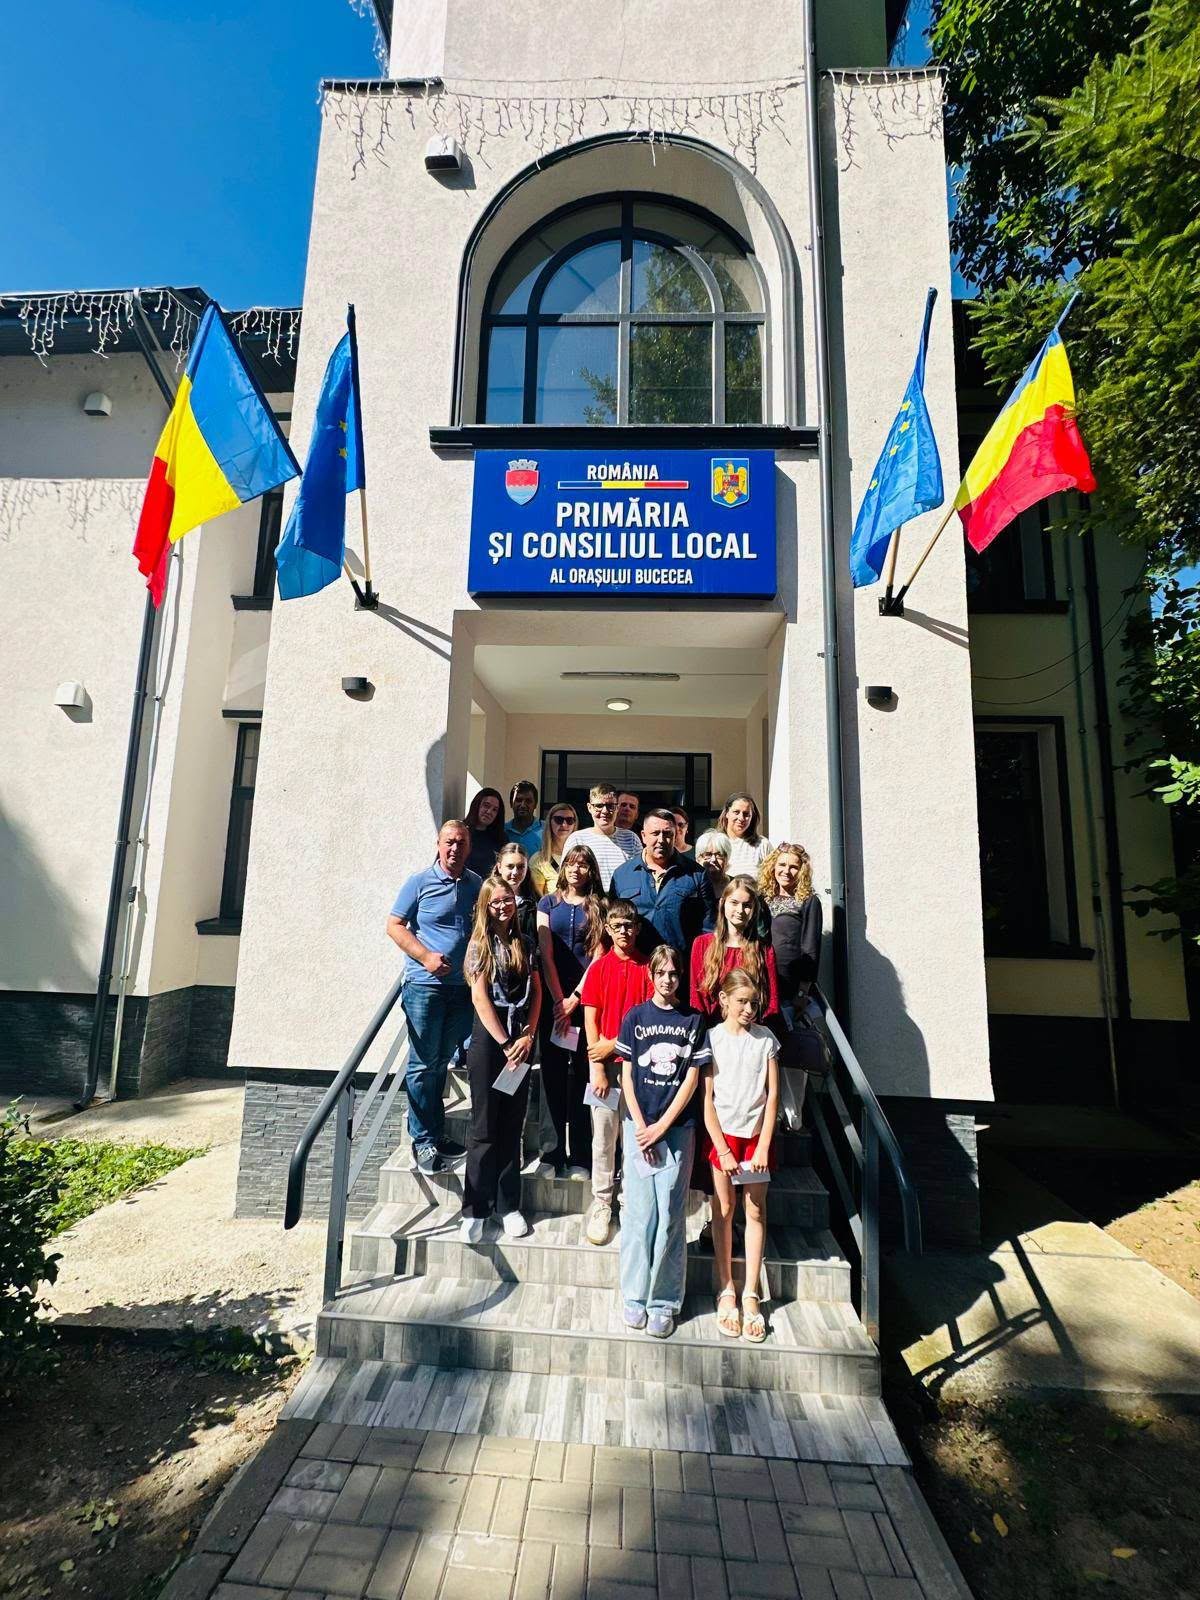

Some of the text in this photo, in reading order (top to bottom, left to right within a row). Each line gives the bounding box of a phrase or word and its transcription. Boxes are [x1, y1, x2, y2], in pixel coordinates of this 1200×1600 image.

[587, 462, 659, 480] ROMÂNIA
[556, 496, 690, 528] PRIMĂRIA
[488, 532, 757, 565] ȘI CONSILIUL LOCAL
[550, 568, 566, 584] AL
[635, 568, 693, 584] BUCECEA
